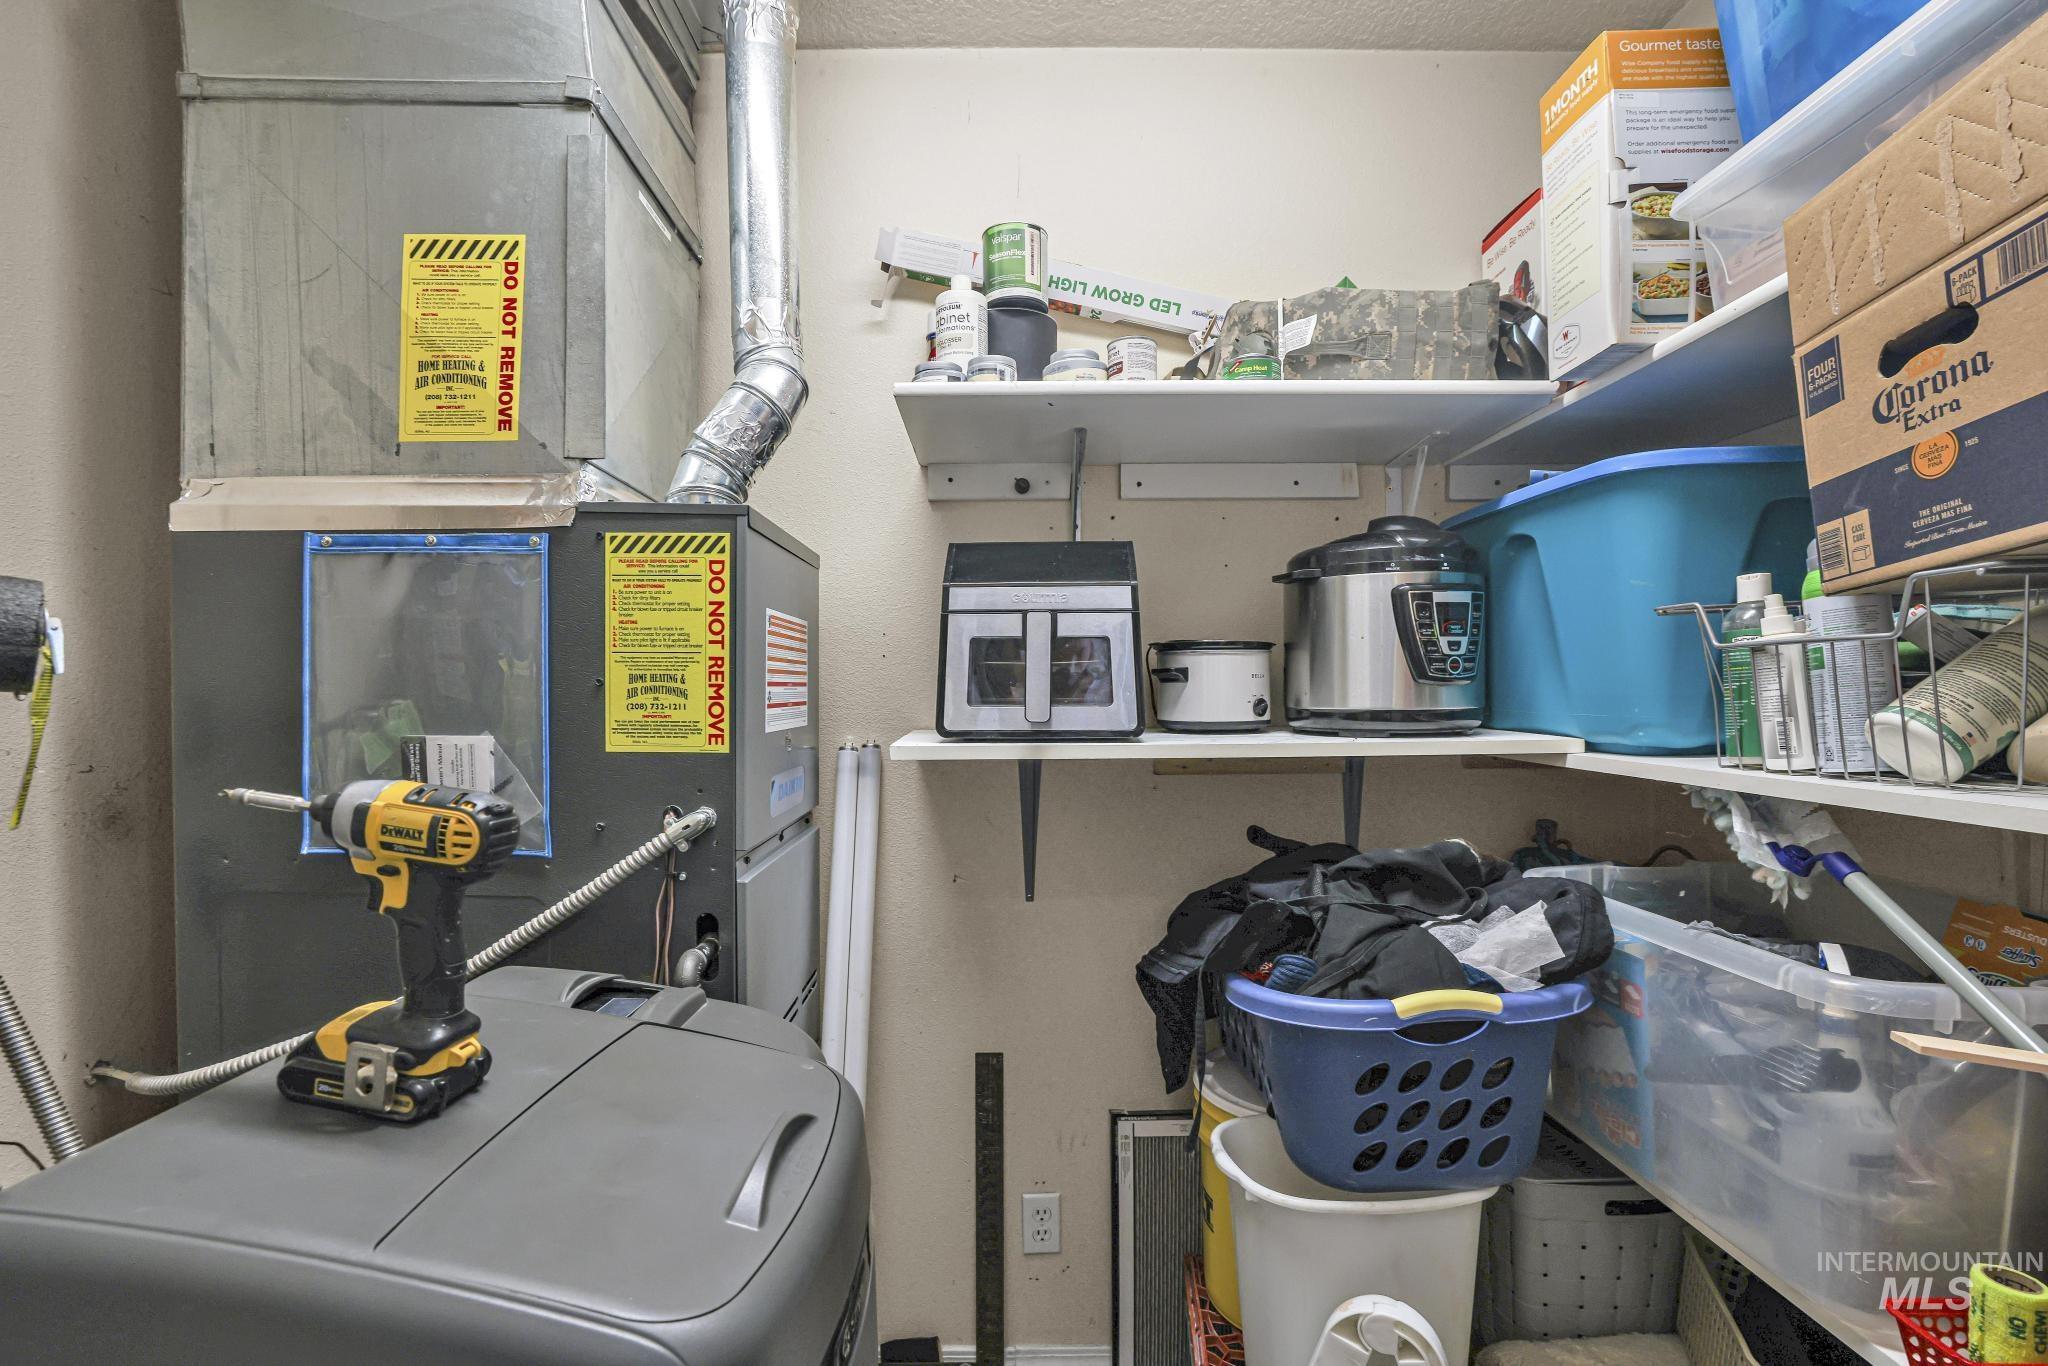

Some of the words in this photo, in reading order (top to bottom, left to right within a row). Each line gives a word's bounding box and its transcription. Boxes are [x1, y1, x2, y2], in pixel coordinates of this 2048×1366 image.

[1620, 40, 1681, 51] Gourmet
[992, 233, 1021, 244] valspar
[503, 261, 518, 290] DO
[1048, 275, 1088, 296] LIGH
[1952, 266, 1977, 286] 6-PACK
[1091, 284, 1144, 307] GROW
[1149, 298, 1181, 316] LED
[501, 298, 517, 339] NOT
[418, 360, 440, 372] HOME
[442, 360, 475, 372] HEATING
[479, 360, 485, 371] &
[1808, 357, 1835, 382] FOUR
[415, 376, 429, 390] AIR
[432, 373, 486, 389] CONDITIONING
[497, 346, 515, 432] REMOVE
[1809, 370, 1837, 391] 6-PACKS
[1872, 351, 1992, 424] Corona
[1902, 398, 1962, 433] Extra
[1919, 444, 1949, 459] CERVEZA
[1928, 460, 1942, 468] FINA
[1913, 514, 1940, 528] CERVEZA
[1941, 510, 1955, 519] MAS
[1957, 504, 1973, 514] FINA
[1920, 509, 1930, 517] THE
[1932, 498, 1963, 513] ORIGINAL
[1852, 523, 1864, 533] CASE
[1853, 532, 1865, 543] CODE
[708, 560, 725, 594] DO
[708, 601, 725, 650] NOT
[628, 674, 648, 684] HOME
[650, 674, 678, 683] HEATING
[680, 674, 686, 684] &
[626, 686, 638, 700] AIR
[641, 685, 688, 700] CONDITIONING
[708, 656, 725, 745] REMOVE
[626, 703, 647, 711] (208)
[381, 824, 424, 841] DEWALT
[2003, 926, 2048, 946] DUSTERS
